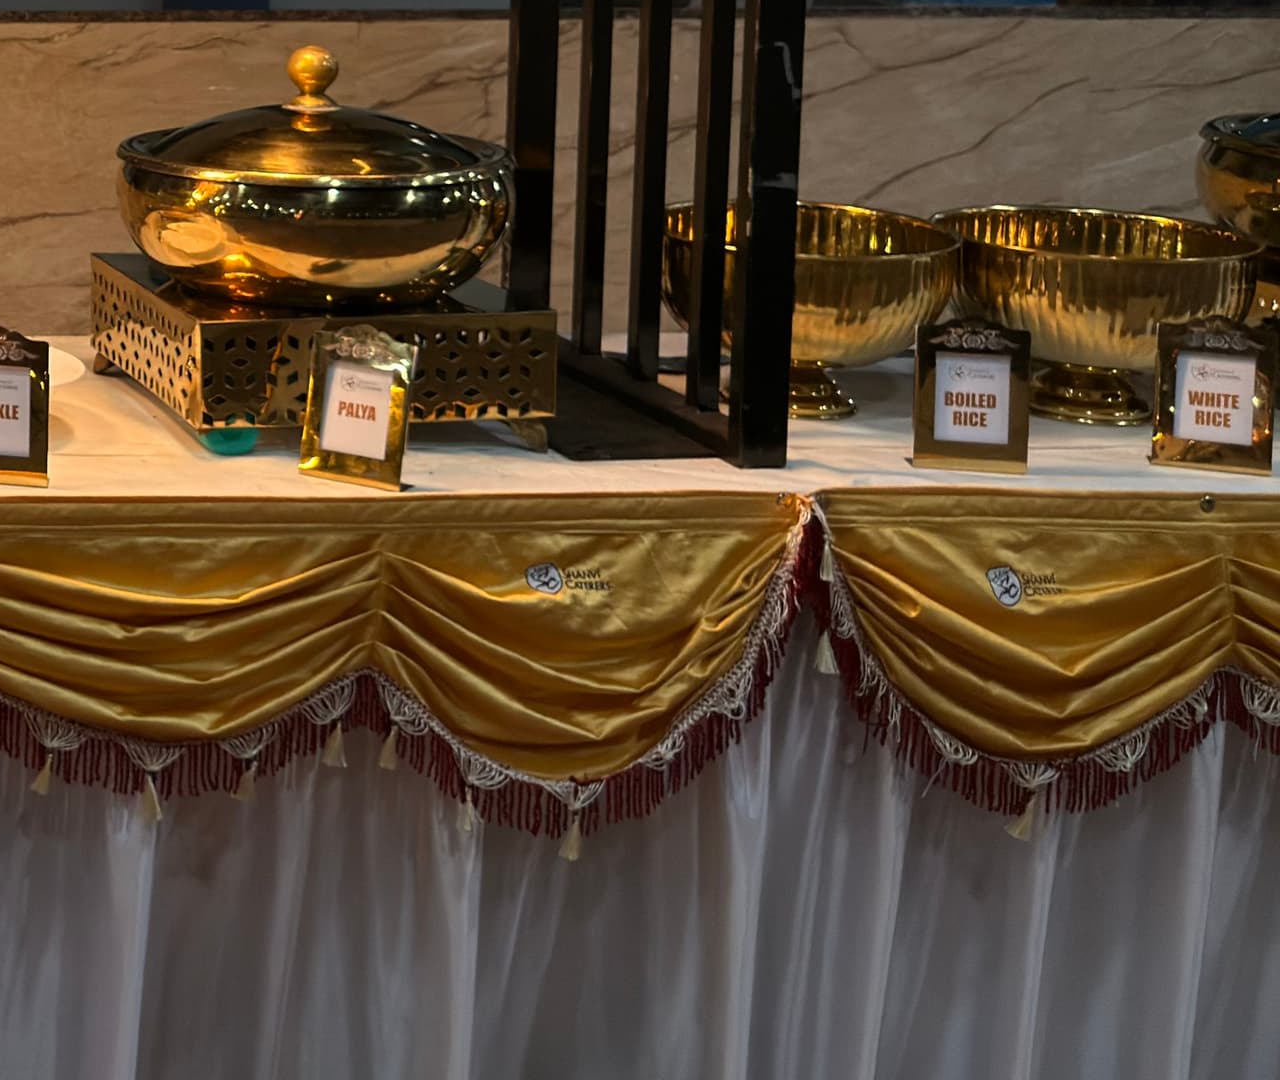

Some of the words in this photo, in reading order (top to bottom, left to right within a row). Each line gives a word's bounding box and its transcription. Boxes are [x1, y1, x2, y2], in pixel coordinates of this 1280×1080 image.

[944, 391, 997, 409] BOILED
[1188, 390, 1240, 410] WHITE
[338, 400, 376, 421] PALYA
[953, 411, 988, 428] RICE
[1195, 410, 1232, 428] RICE
